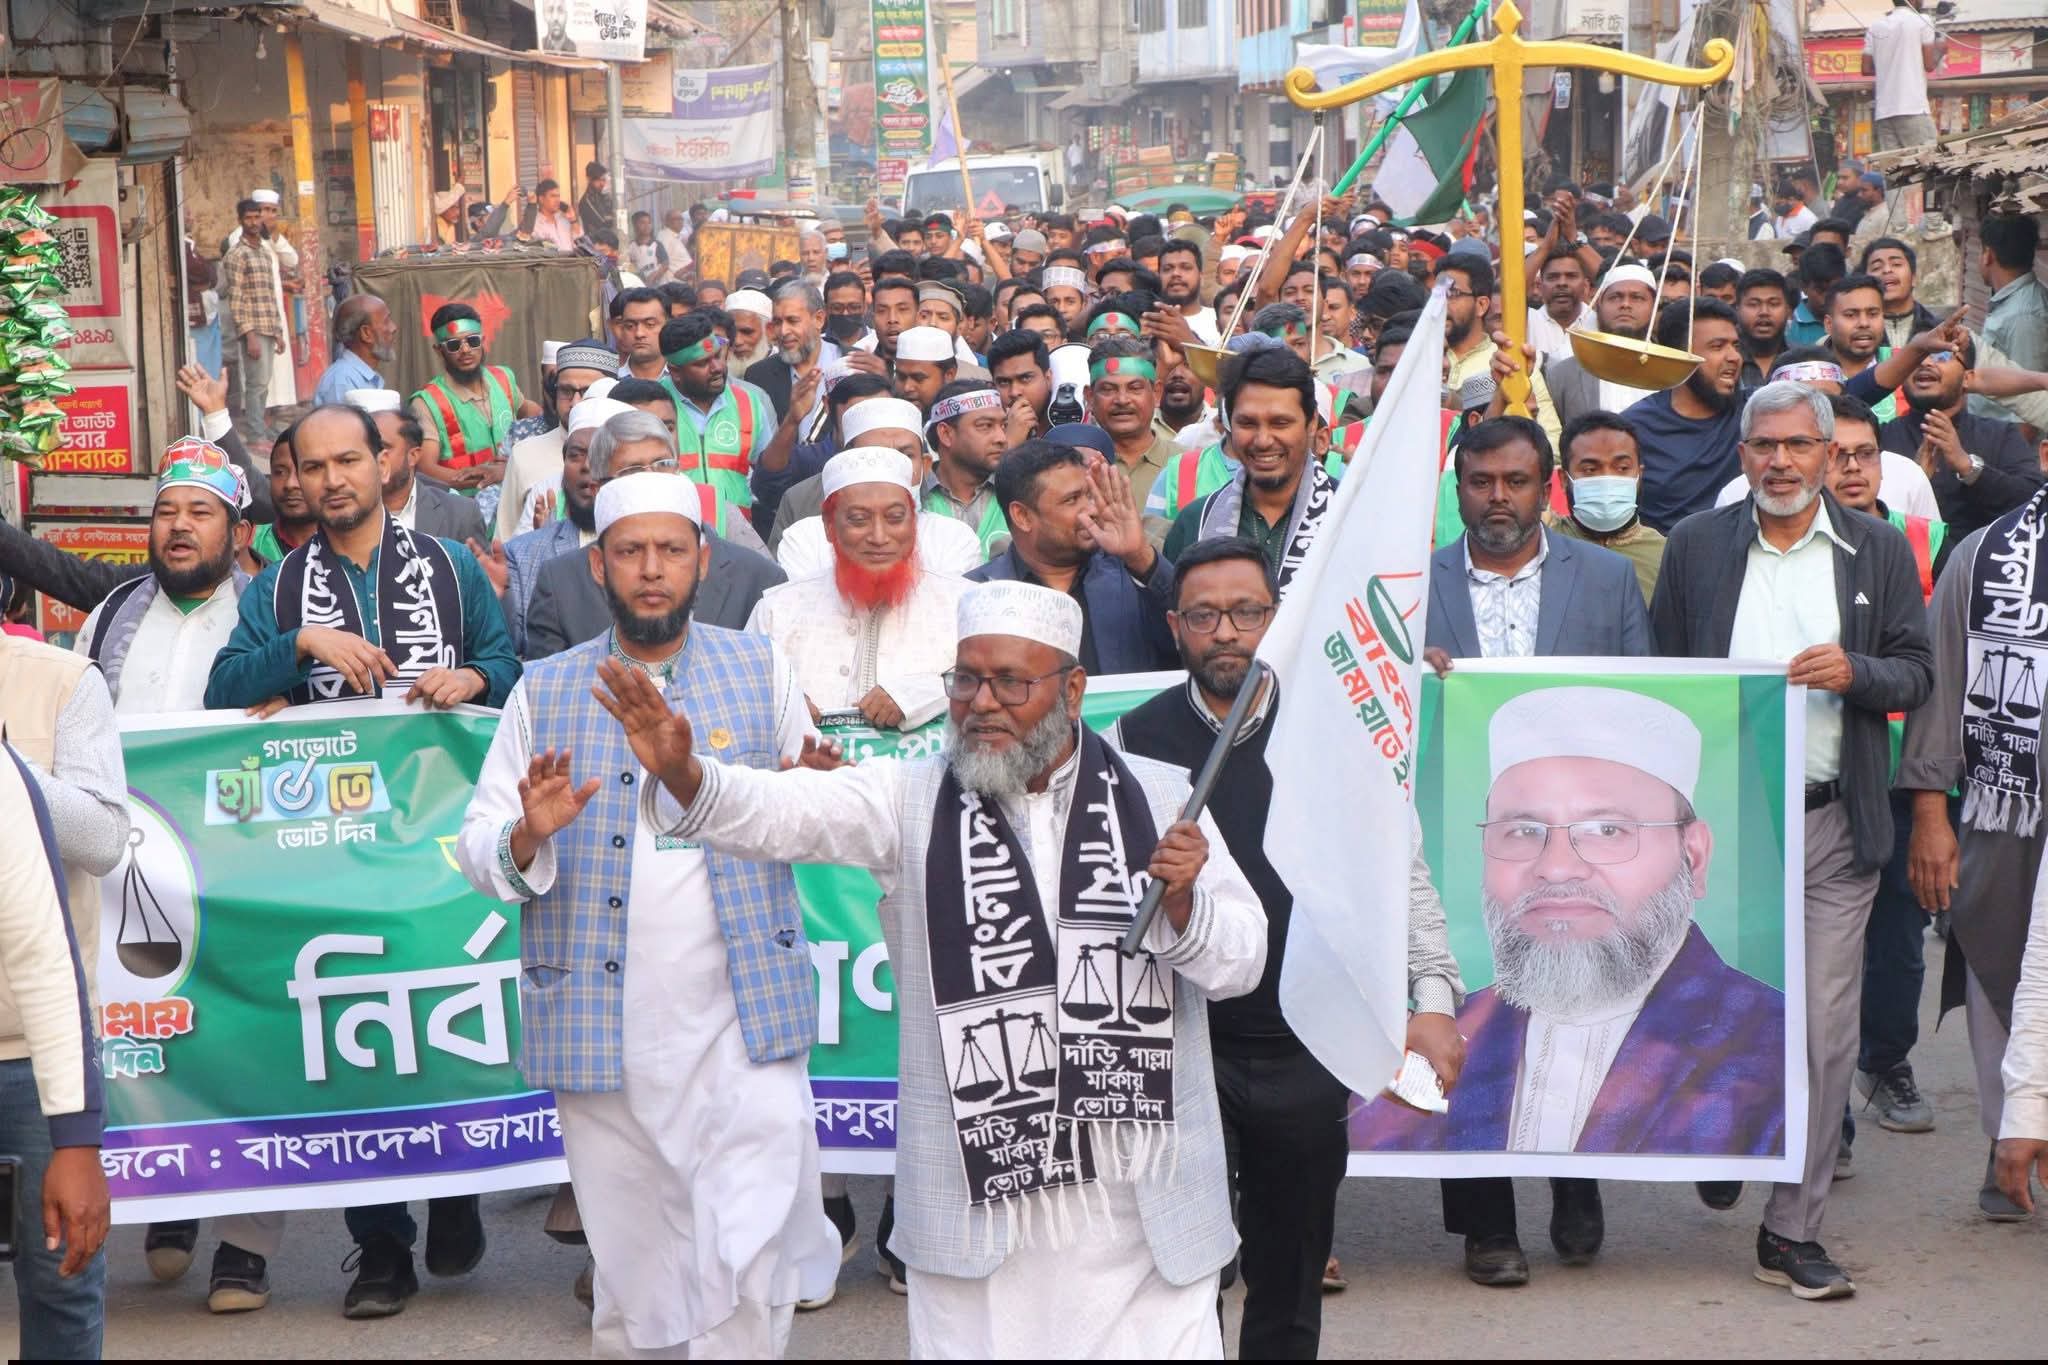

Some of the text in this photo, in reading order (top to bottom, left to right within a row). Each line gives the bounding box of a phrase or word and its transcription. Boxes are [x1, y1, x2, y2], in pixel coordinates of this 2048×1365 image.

[72, 411, 116, 429] আউট
[62, 431, 106, 449] তবার
[262, 730, 358, 762] গণভোটে
[1997, 767, 2031, 793] দিন
[276, 817, 377, 851] ভোট দিন
[287, 910, 524, 1082] নির্ব
[1061, 1035, 1173, 1072] দাঁড়ি পাল্লা
[1083, 1065, 1145, 1093] মার্কায়
[1074, 1090, 1166, 1119] ভোট দিন
[960, 1114, 1017, 1149] দাঁড়ি
[99, 1143, 193, 1180] জনে
[236, 1120, 449, 1172] বাংলাদেশ
[984, 1165, 1034, 1198] ভোট
